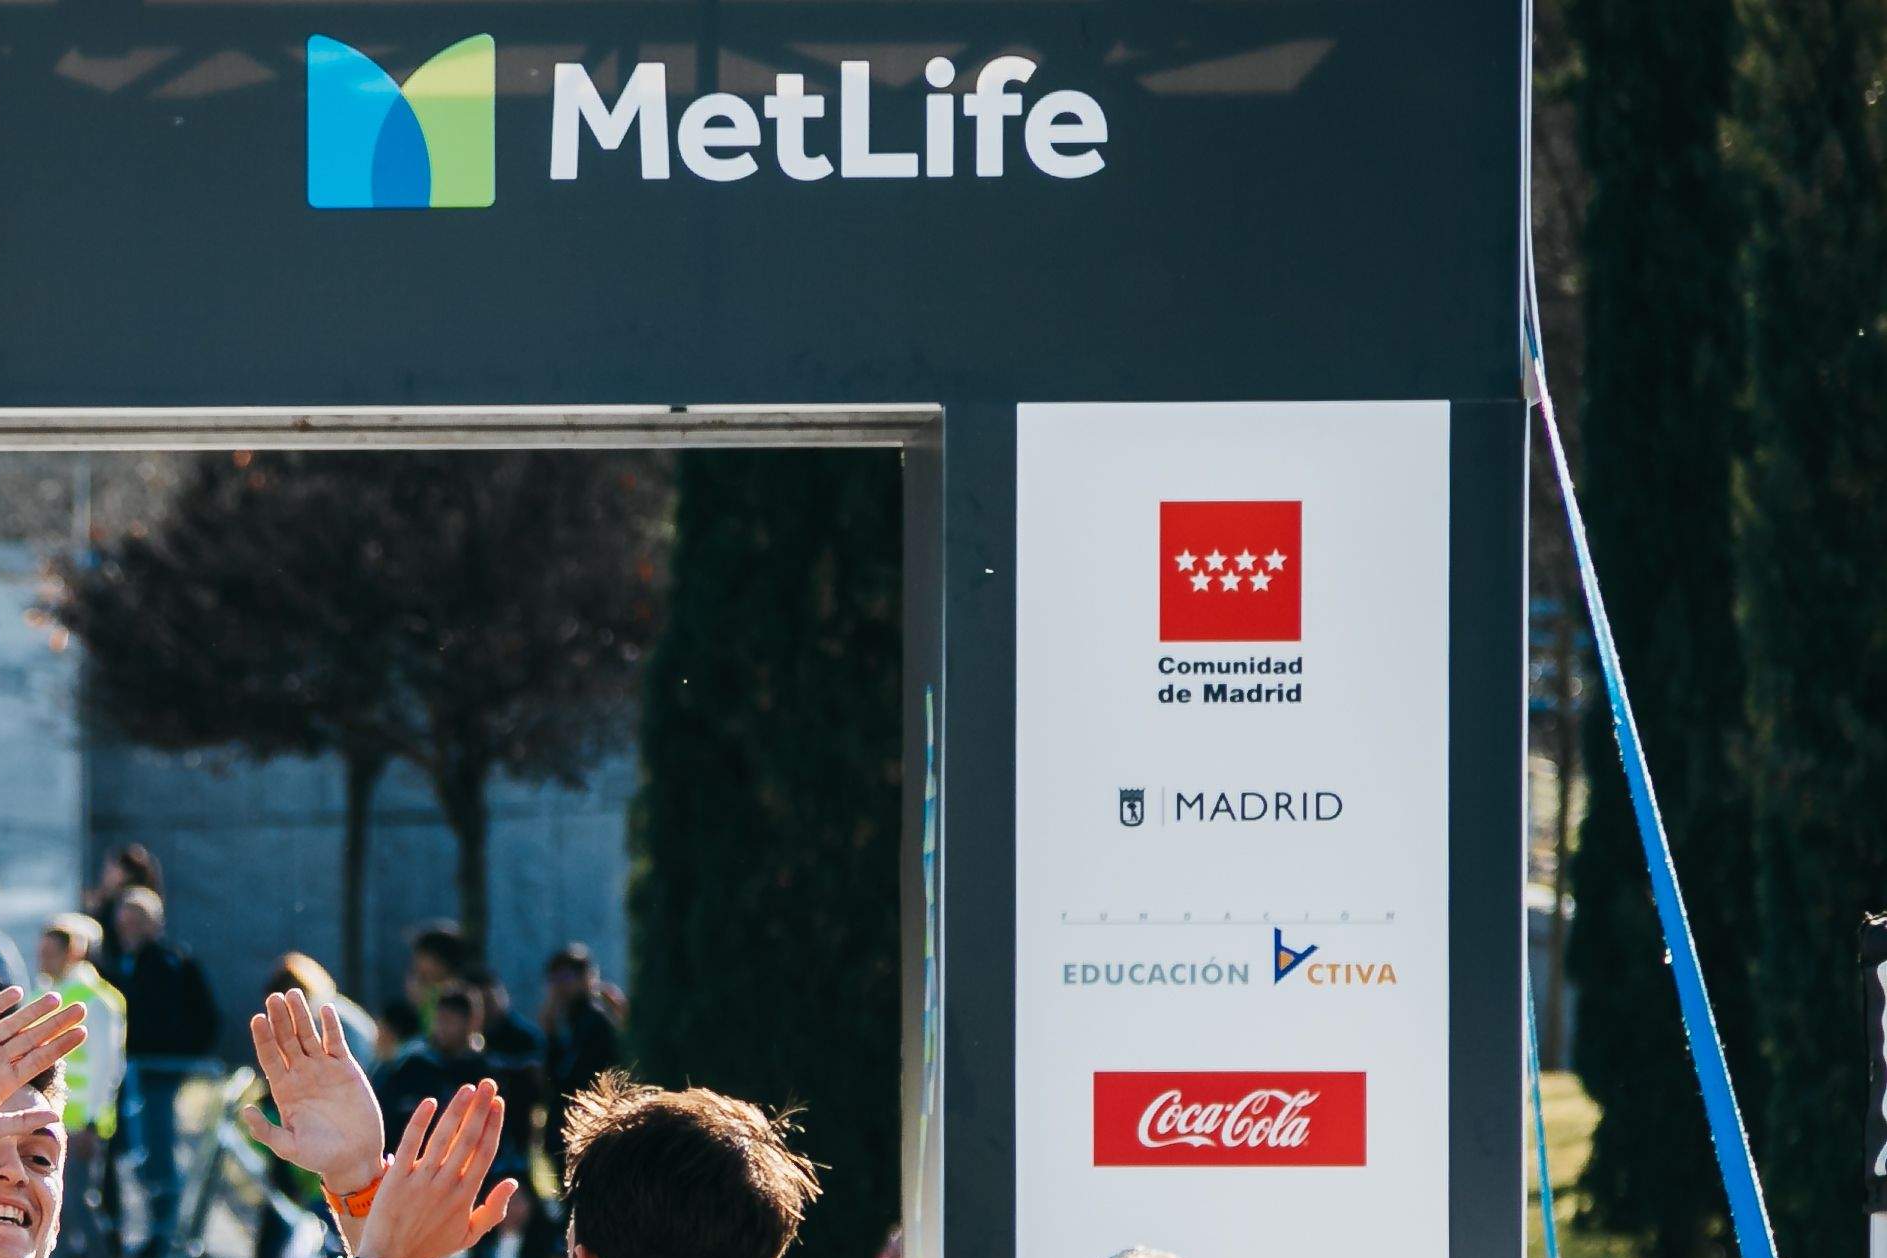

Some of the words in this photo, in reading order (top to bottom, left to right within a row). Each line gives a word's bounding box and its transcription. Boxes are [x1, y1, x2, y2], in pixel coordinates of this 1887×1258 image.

[550, 54, 1109, 182] MetLife
[1158, 656, 1303, 676] Comunidad
[1158, 683, 1192, 704] de
[1203, 682, 1303, 704] Madrid
[1176, 792, 1344, 822] MADRID
[1063, 956, 1250, 985] EDUCACIÓN
[1137, 1088, 1321, 1149] Coca-Cola
